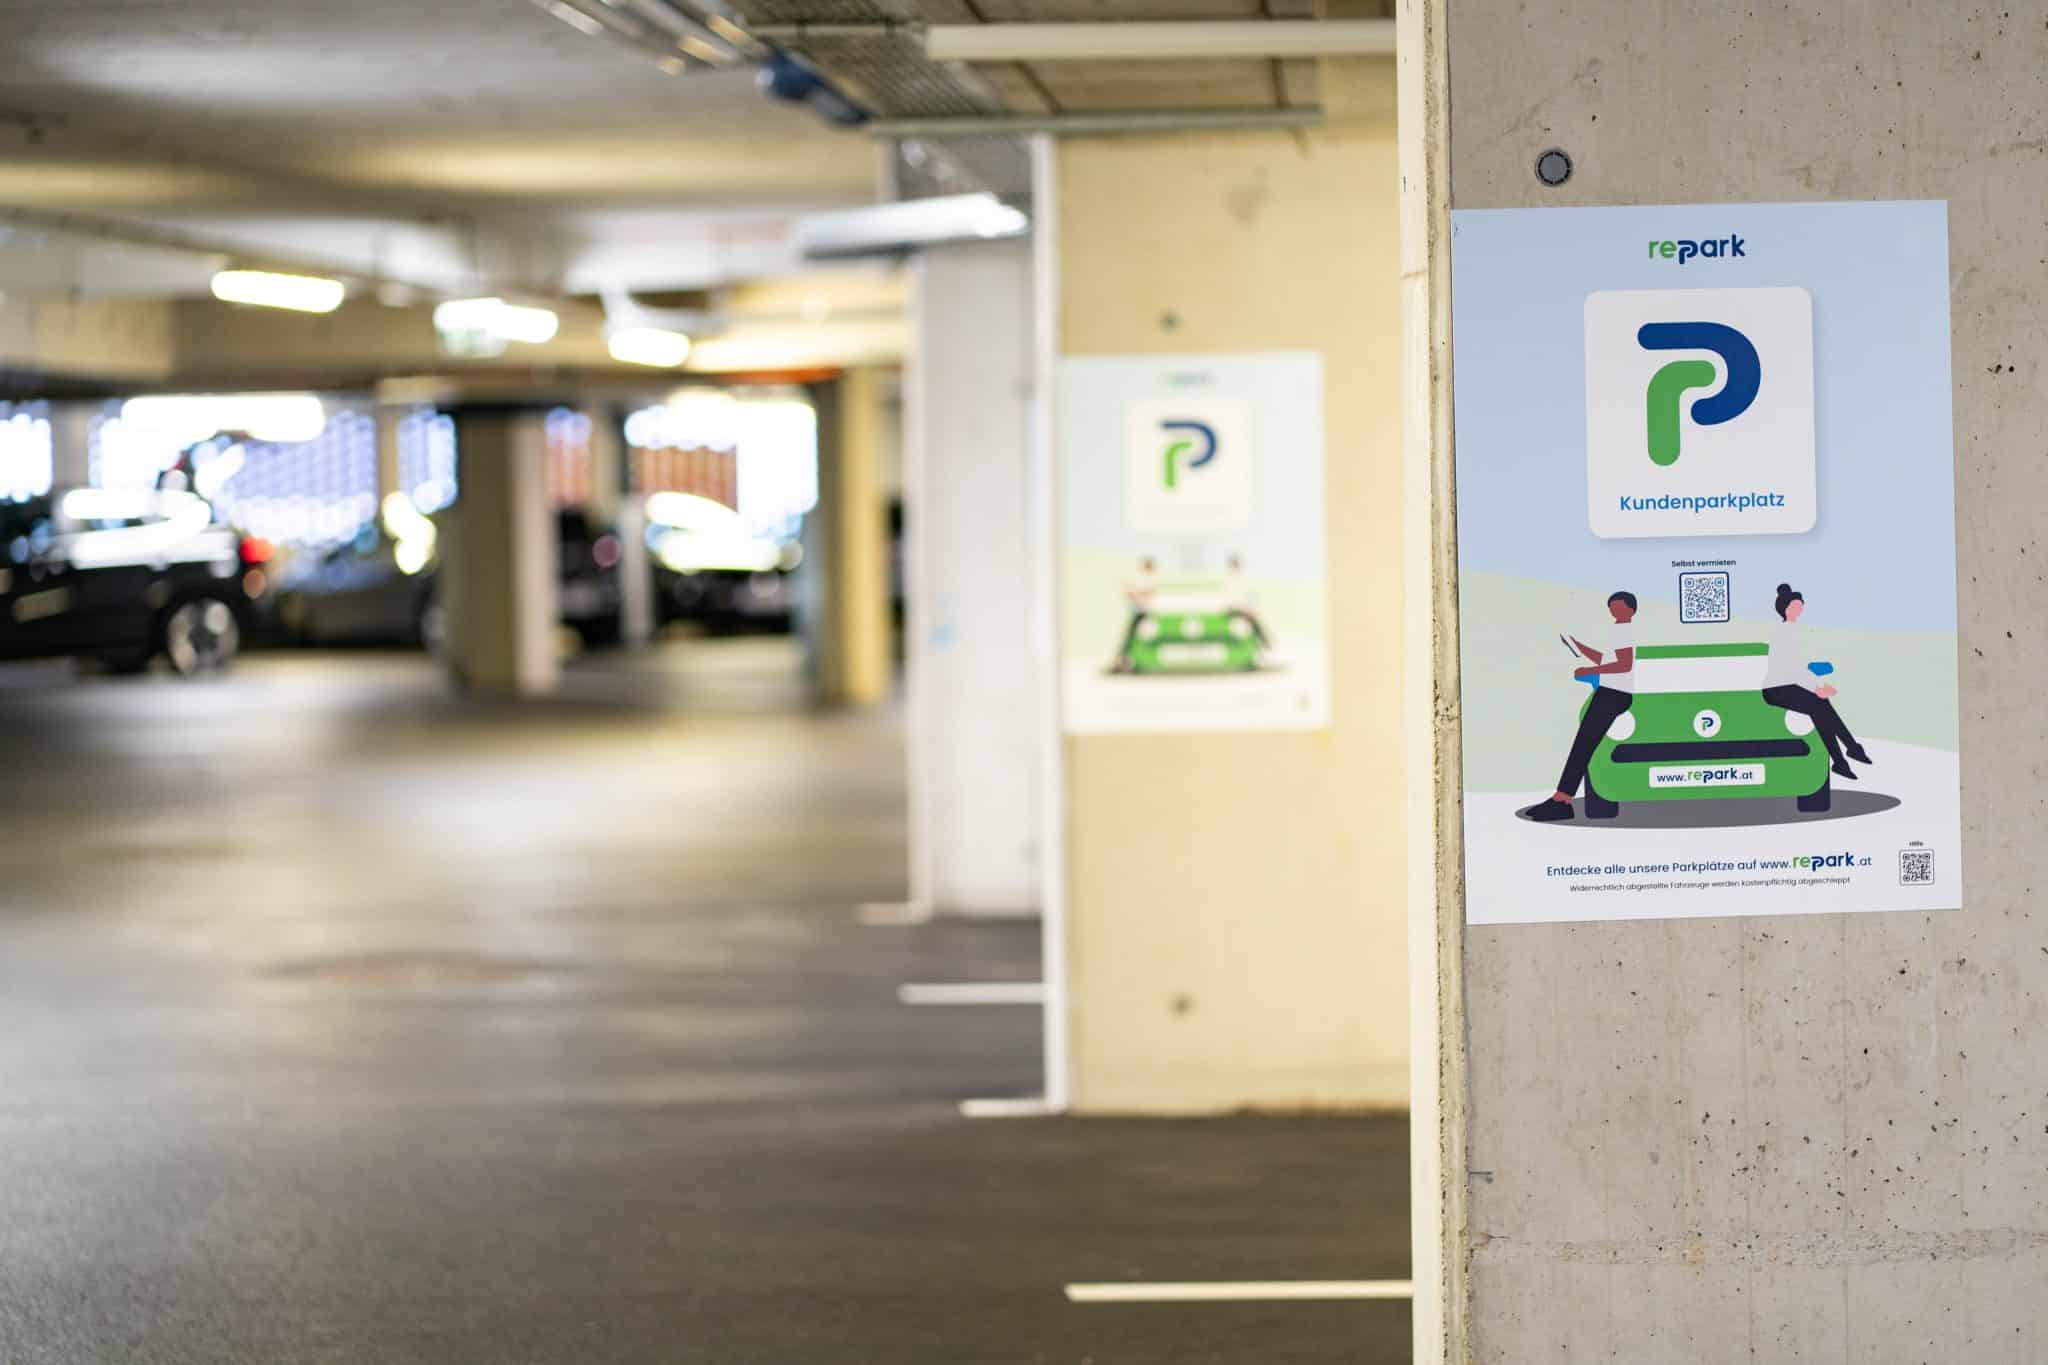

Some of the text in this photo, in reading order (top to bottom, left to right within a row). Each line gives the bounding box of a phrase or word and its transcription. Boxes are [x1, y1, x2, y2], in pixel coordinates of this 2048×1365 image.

[1648, 233, 1745, 264] repark
[1620, 492, 1785, 513] Kundenparkplatz
[1697, 559, 1737, 567] vermieten
[1656, 767, 1753, 783] www.repark.at
[1547, 865, 1601, 876] Entdecke
[1604, 863, 1625, 874] alle
[1629, 864, 1669, 873] unsere
[1672, 861, 1734, 874] Parkplätze
[1737, 859, 1757, 870] auf
[1569, 883, 1624, 892] Widerrechtlich
[1670, 881, 1710, 889] Fahrzeuge
[1711, 879, 1739, 887] werden
[1741, 878, 1797, 887] kostenpflichtig
